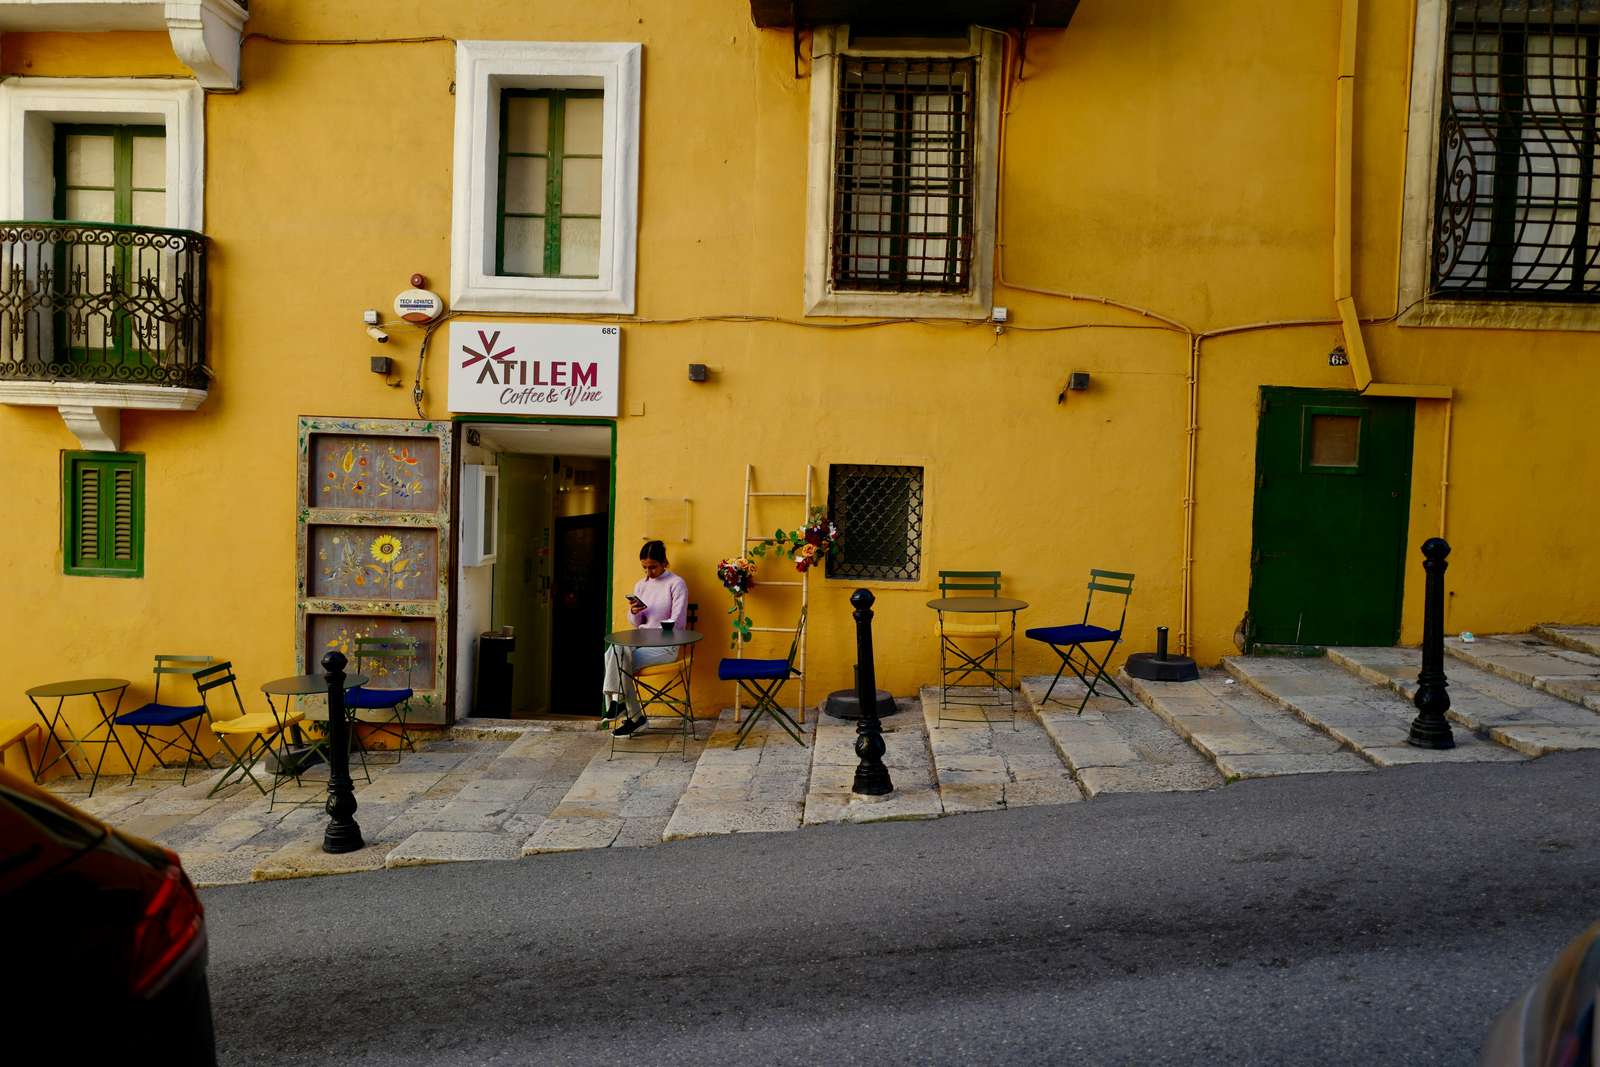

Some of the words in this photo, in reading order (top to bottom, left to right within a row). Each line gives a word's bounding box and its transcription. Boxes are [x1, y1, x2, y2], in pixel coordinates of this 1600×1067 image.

[602, 327, 617, 335] 68C
[500, 387, 544, 405] Coffee
[546, 388, 559, 403] &
[561, 386, 602, 406] Wine
